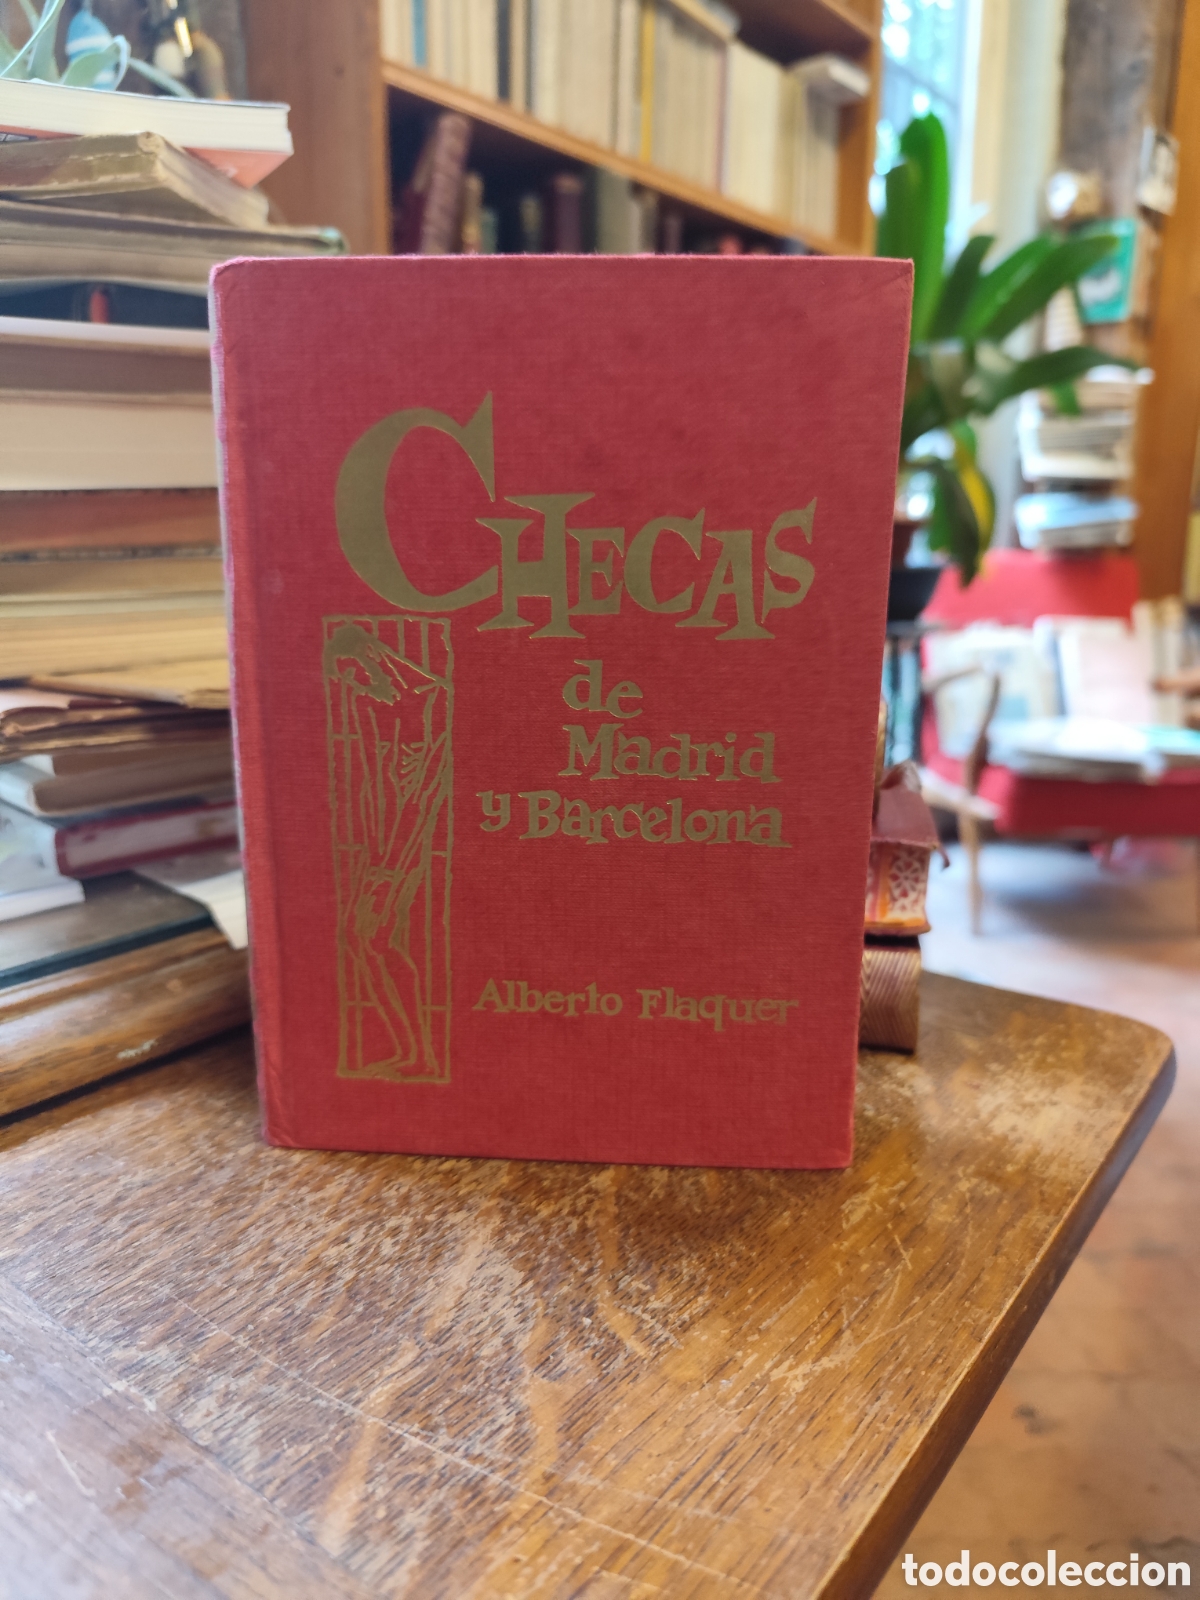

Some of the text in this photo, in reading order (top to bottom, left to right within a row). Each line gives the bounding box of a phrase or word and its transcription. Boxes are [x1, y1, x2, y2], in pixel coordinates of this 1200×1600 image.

[335, 391, 817, 640] CHECAS
[562, 659, 643, 718] de
[558, 723, 782, 783] Madrid
[476, 790, 792, 848] y Barcelona
[472, 978, 798, 1032] Alberto Flaquer
